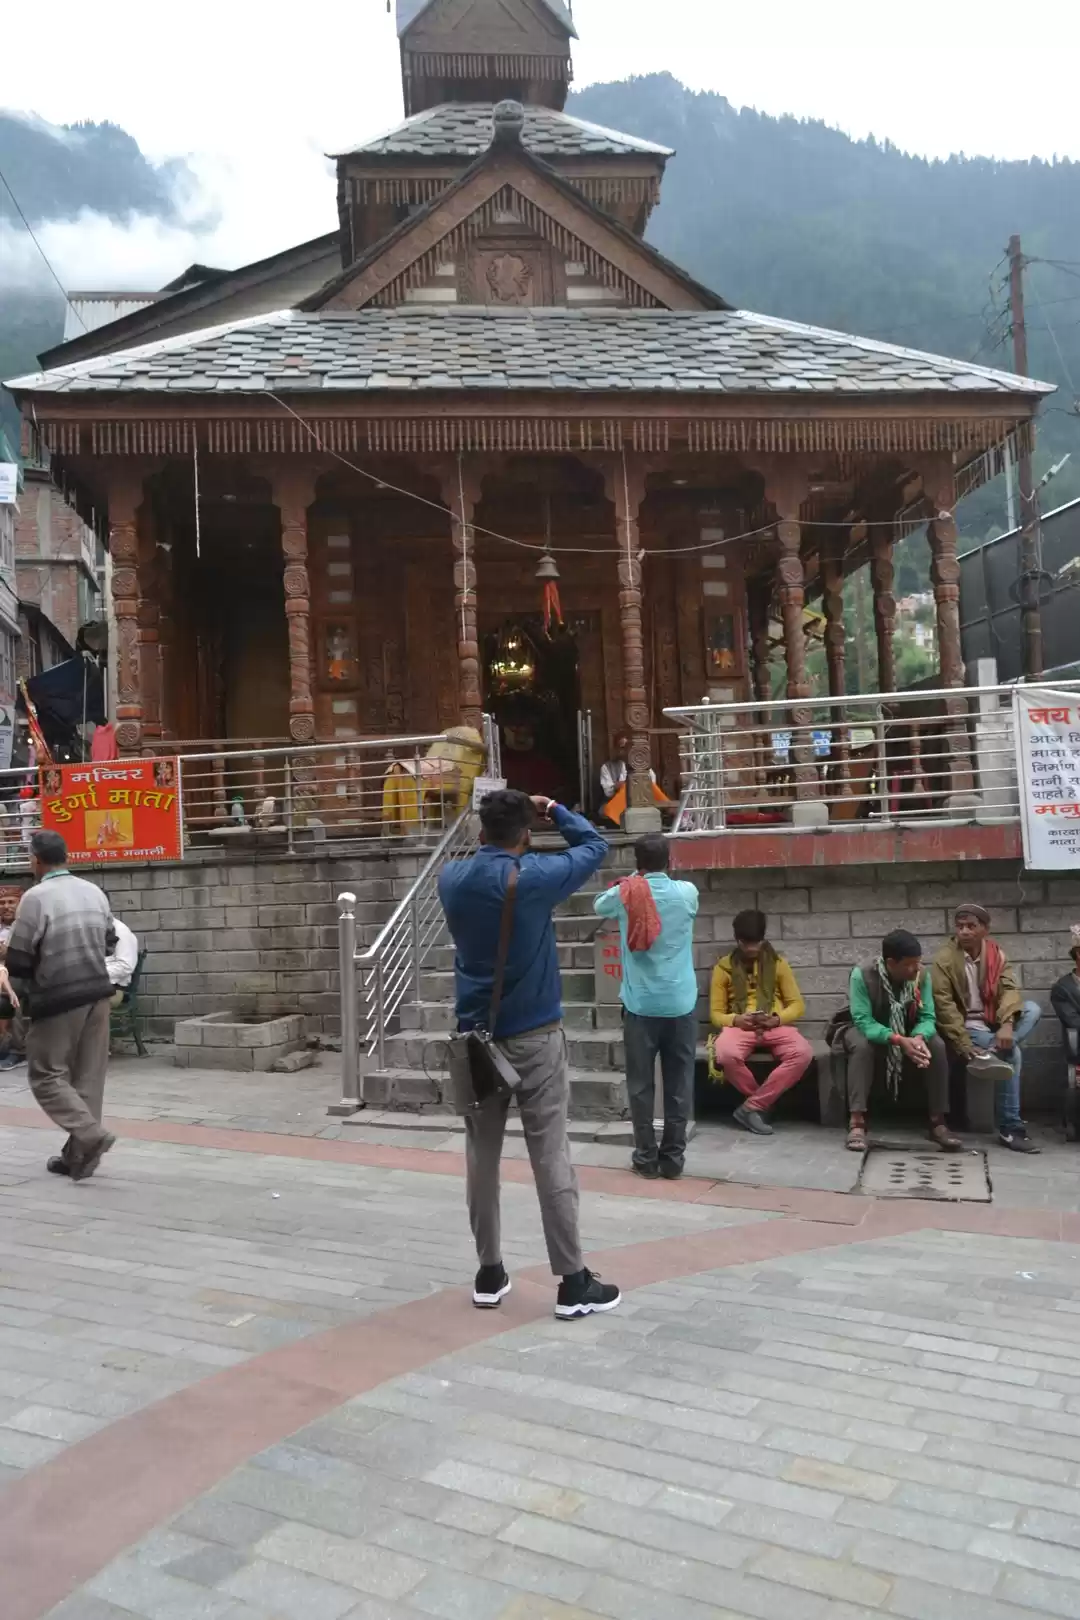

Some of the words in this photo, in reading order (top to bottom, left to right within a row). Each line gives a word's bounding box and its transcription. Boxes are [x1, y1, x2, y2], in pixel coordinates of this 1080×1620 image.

[1028, 707, 1071, 725] जय
[1030, 735, 1063, 744] आज
[1031, 749, 1066, 758] माता
[1031, 760, 1076, 773] निर्माण
[70, 768, 144, 783] मन्दिर
[1031, 774, 1062, 787] दानी
[1032, 787, 1064, 800] चाहते
[48, 784, 99, 822] दुर्गा
[109, 789, 178, 811] माता
[1048, 838, 1077, 846] माता
[123, 845, 166, 857] मनाली
